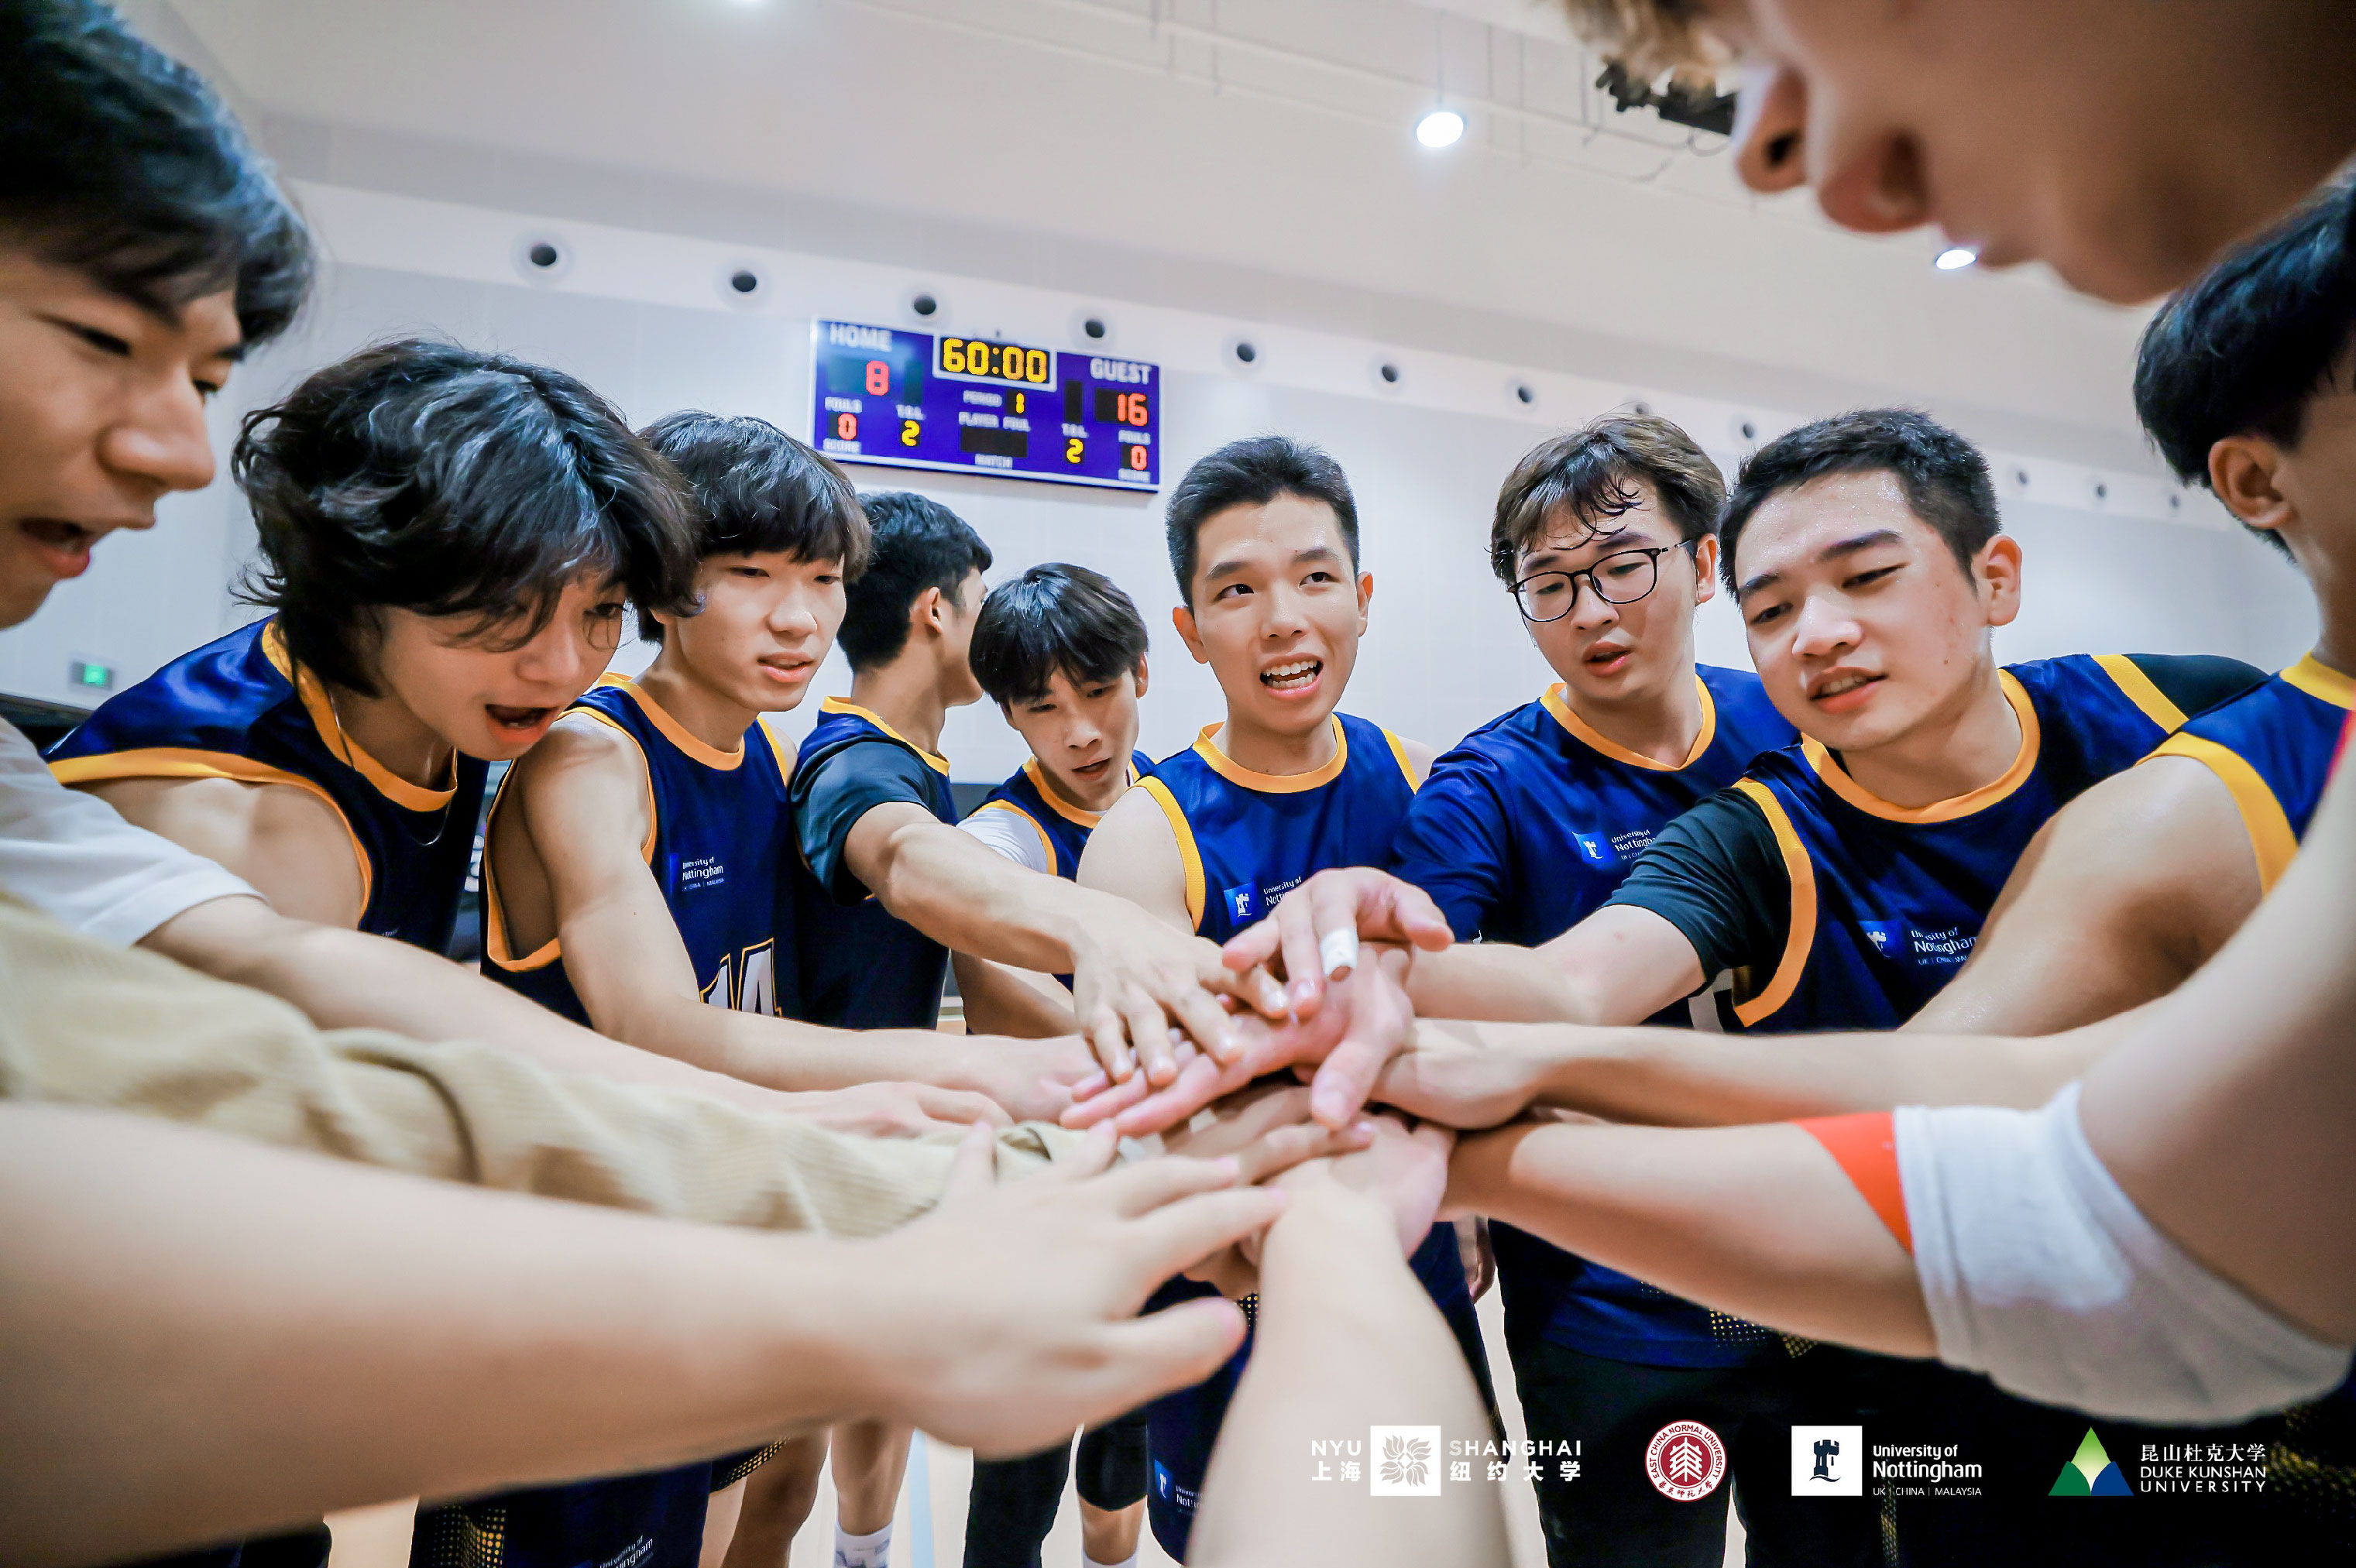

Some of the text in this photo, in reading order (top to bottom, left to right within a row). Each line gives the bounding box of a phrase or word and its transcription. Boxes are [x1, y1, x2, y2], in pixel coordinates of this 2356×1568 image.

[829, 322, 892, 352] HOME
[943, 338, 1047, 383] 60:00
[1090, 357, 1152, 385] GUEST
[866, 360, 890, 396] 8
[1015, 393, 1025, 414] 1
[1117, 393, 1149, 427] 16
[837, 411, 858, 441] 0
[902, 419, 921, 447] 2
[1066, 438, 1084, 464] 2
[1130, 444, 1148, 471] 0
[1263, 880, 1295, 894] University
